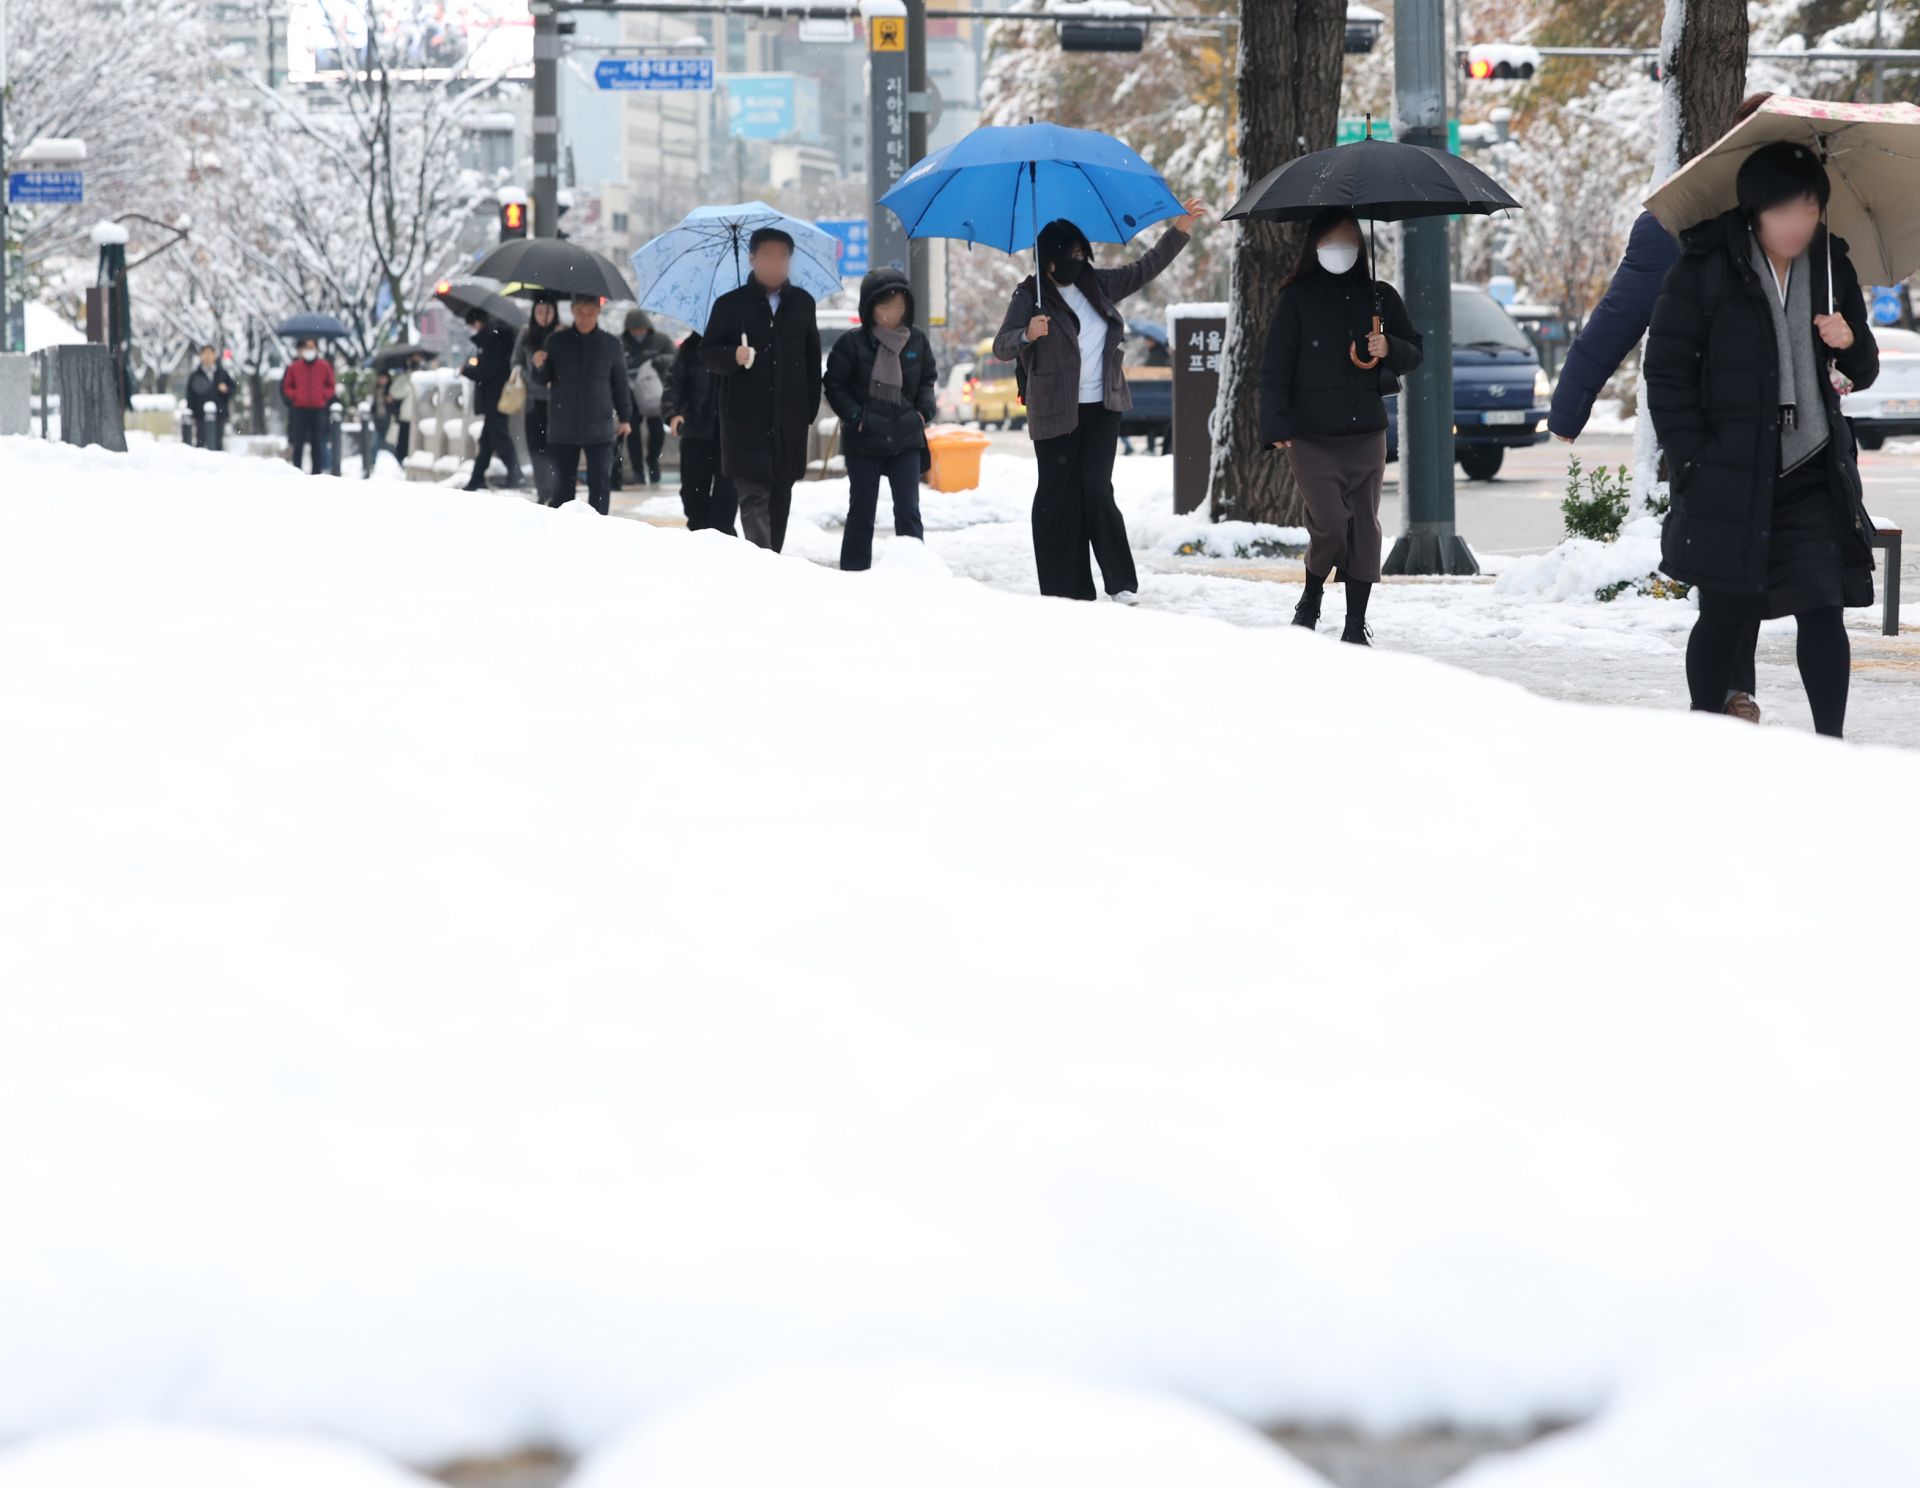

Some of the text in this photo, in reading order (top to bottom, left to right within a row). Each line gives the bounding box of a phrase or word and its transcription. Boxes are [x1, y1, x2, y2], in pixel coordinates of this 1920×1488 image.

[886, 76, 903, 134] 지하철
[886, 141, 903, 179] 타는
[1189, 330, 1222, 351] 서울
